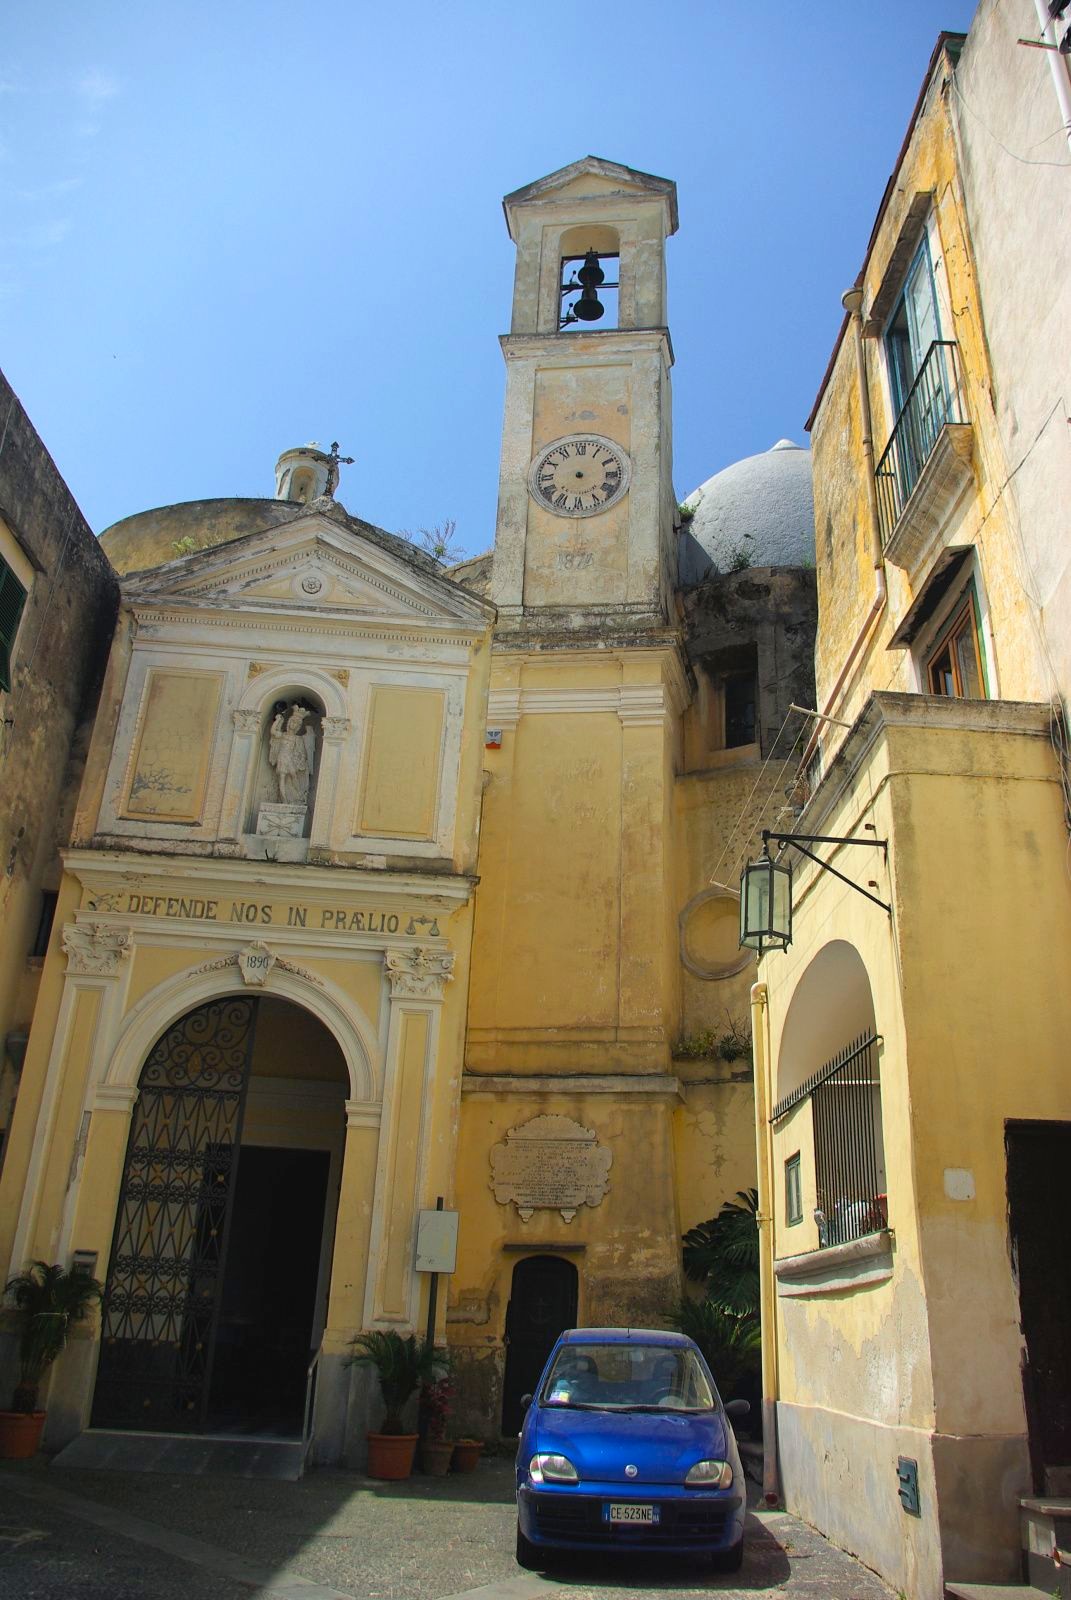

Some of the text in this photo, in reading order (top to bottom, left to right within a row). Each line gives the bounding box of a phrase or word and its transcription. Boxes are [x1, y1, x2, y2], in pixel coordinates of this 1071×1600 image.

[127, 894, 400, 934] DEFENDE NOS IN PRÆLIO
[246, 955, 270, 969] 1890
[610, 1507, 622, 1520] CE
[624, 1507, 652, 1520] 523NE
